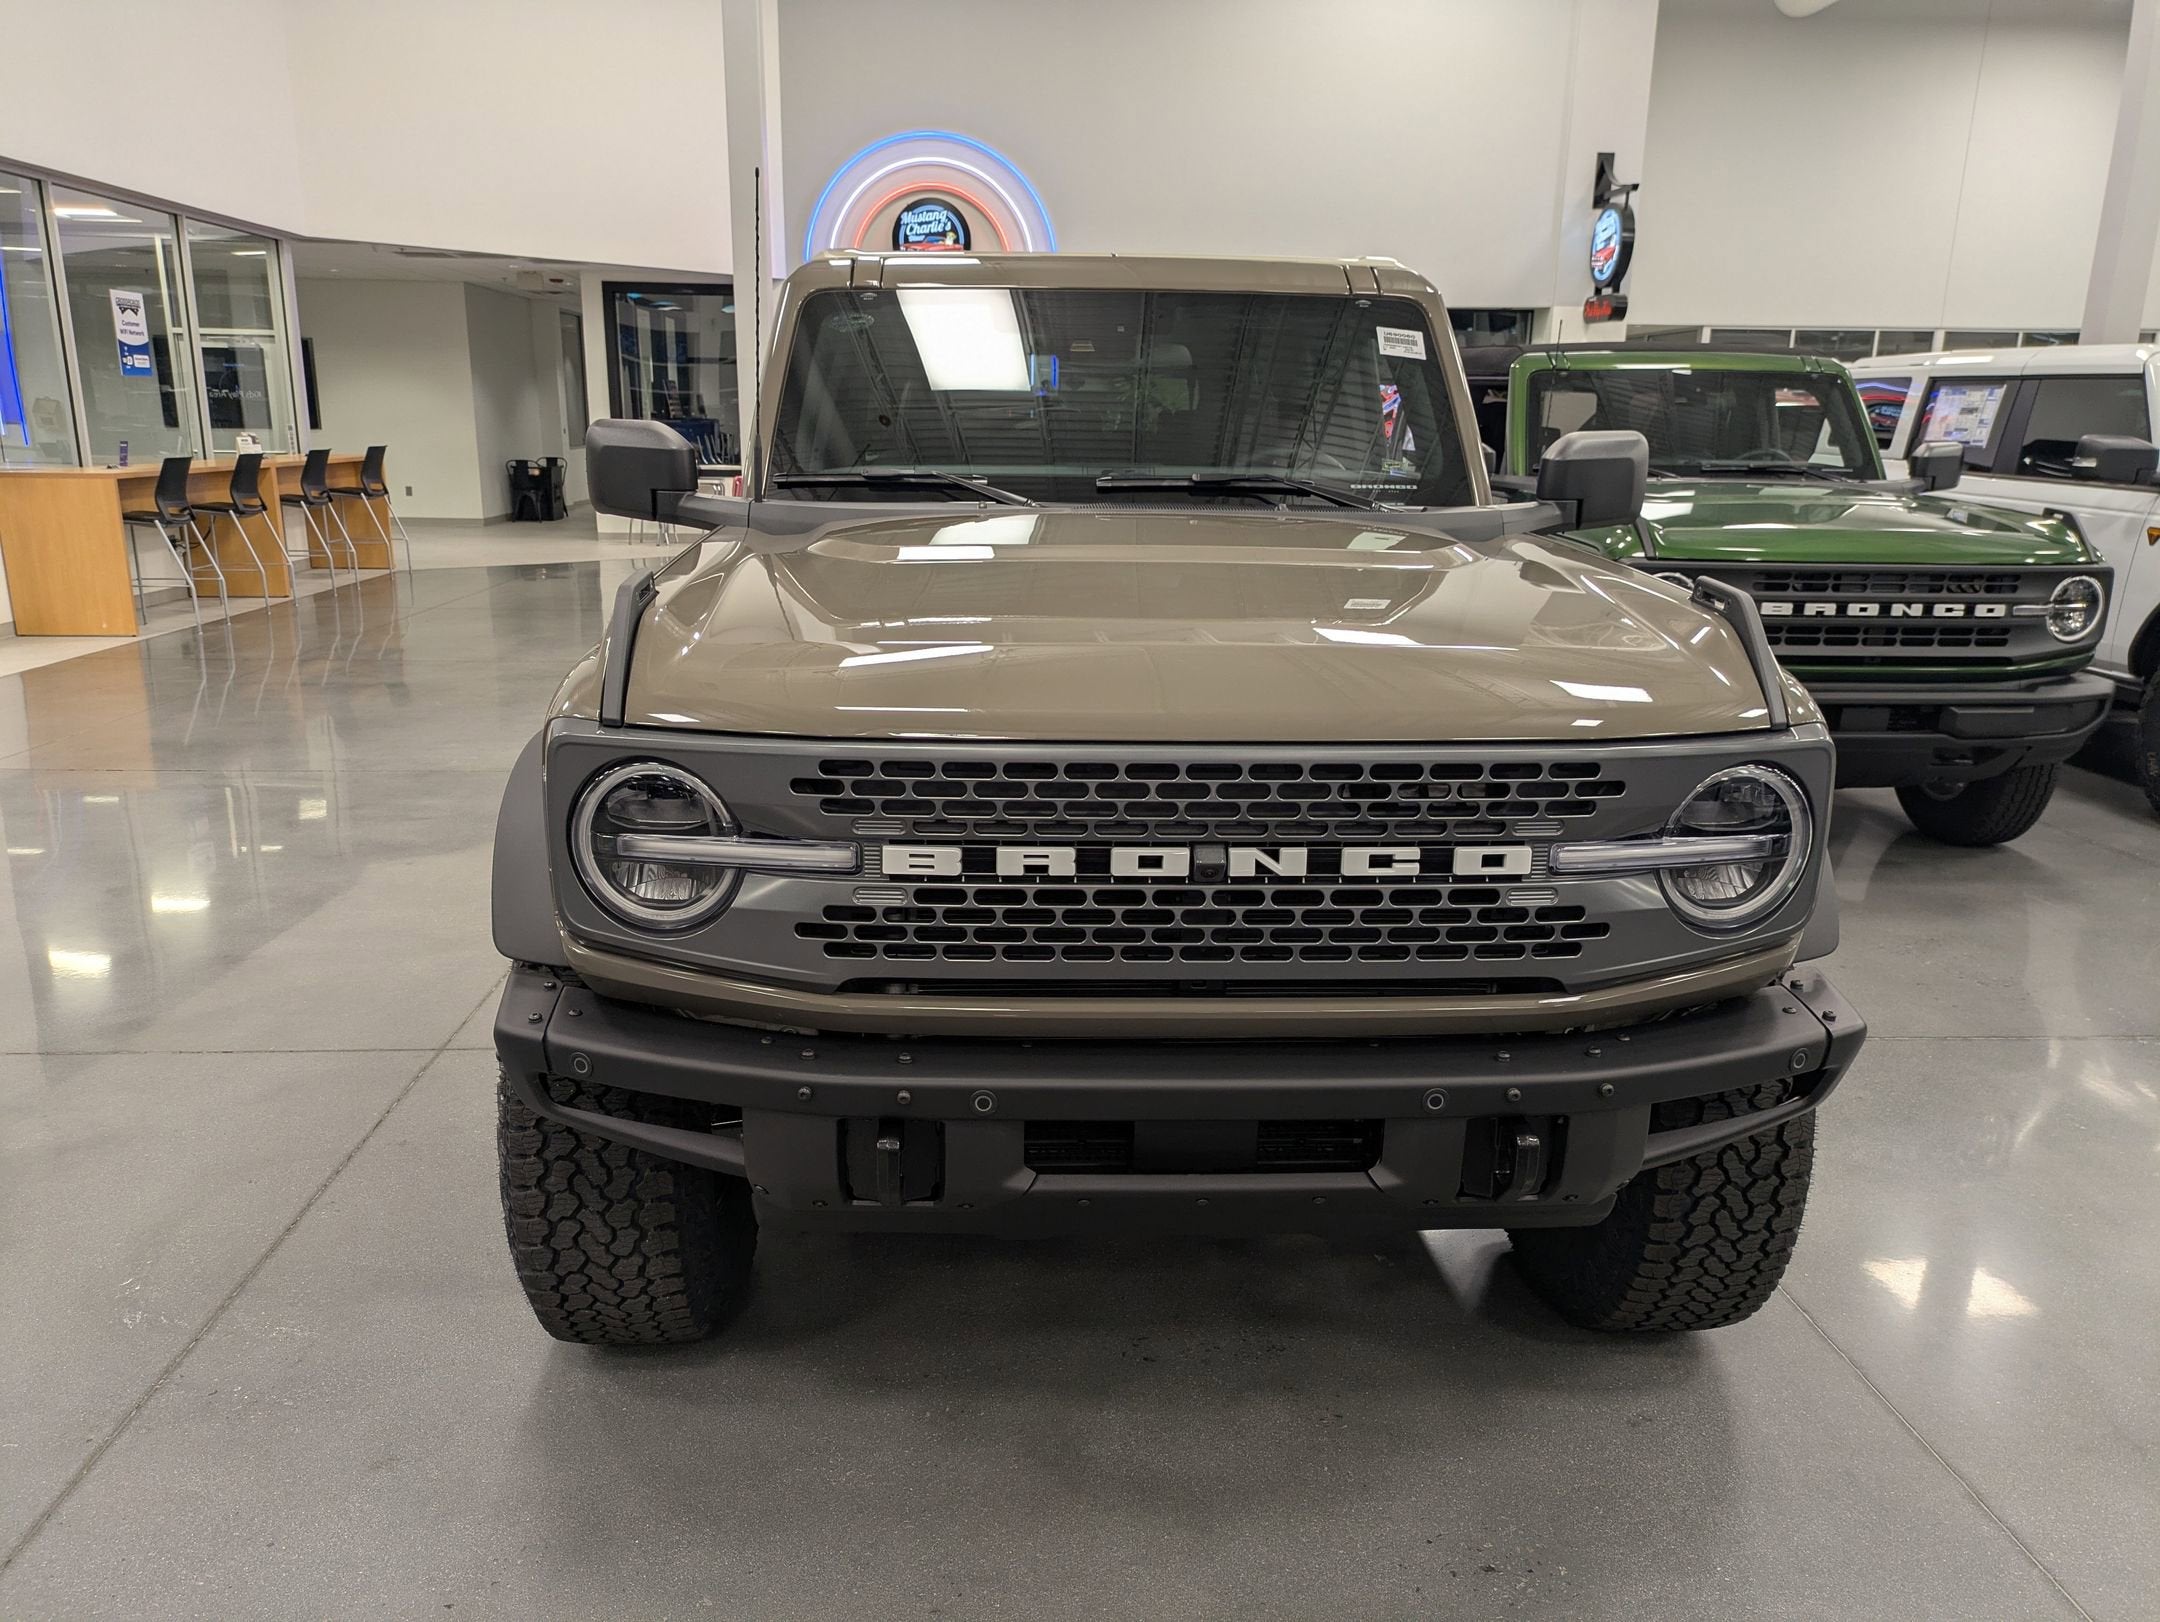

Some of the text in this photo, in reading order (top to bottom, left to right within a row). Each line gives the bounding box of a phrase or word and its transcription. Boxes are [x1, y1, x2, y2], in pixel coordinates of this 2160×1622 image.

[901, 210, 948, 224] Mustang
[906, 219, 952, 235] Charlie's
[1760, 602, 2006, 617] BRONCO
[882, 844, 1532, 877] BRONCO
